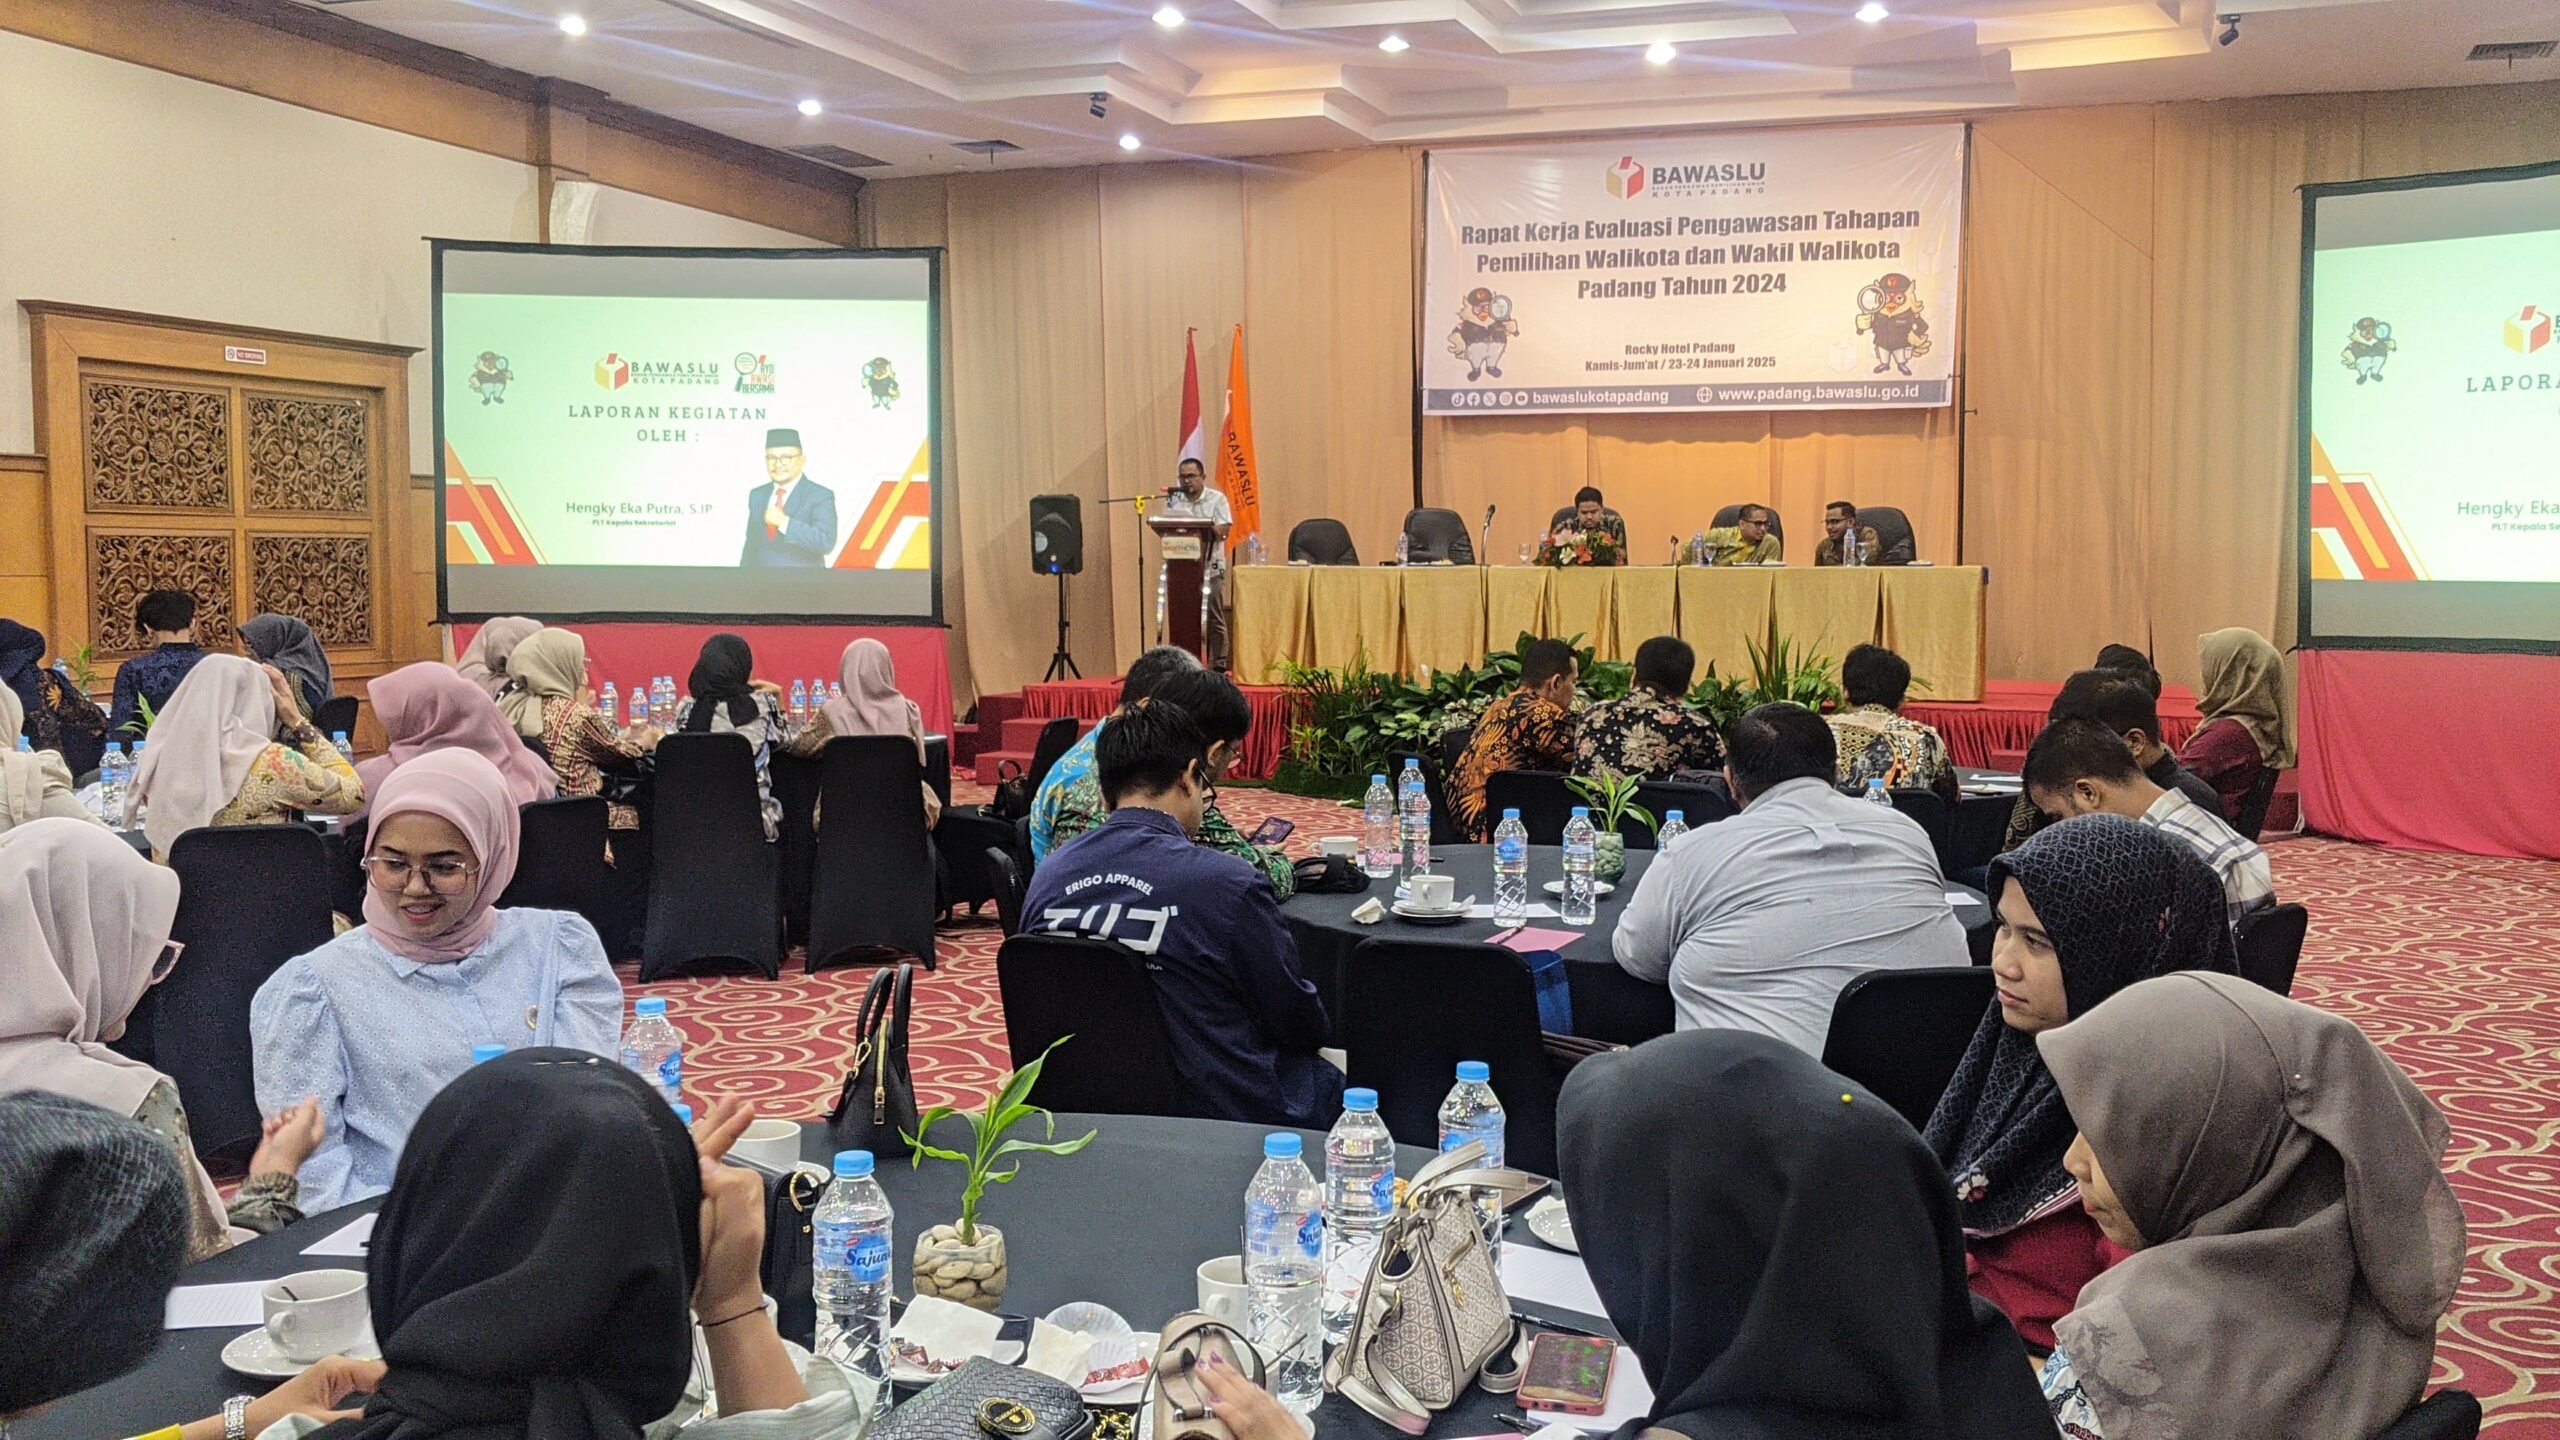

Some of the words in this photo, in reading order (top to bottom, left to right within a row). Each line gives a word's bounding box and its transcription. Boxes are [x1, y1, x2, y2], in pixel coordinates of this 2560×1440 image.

[1652, 162, 1766, 185] BAWASLU
[1652, 190, 1692, 198] KOTA
[1700, 187, 1765, 196] PADANG
[1461, 224, 1520, 246] Rapat
[1524, 222, 1580, 243] Kerja
[1584, 217, 1673, 240] Evaluasi
[1677, 214, 1818, 237] Pengawasan
[1823, 209, 1920, 231] Tahapan
[1476, 251, 1581, 274] Pemilihan
[1585, 248, 1680, 270] Walikota
[1685, 245, 1726, 266] dan
[1731, 242, 1794, 264] Wakil
[1799, 240, 1901, 262] Walikota
[1578, 278, 1657, 300] Padang
[1661, 275, 1727, 296] Tahun
[1732, 273, 1787, 294] 2024
[1625, 344, 1659, 356] Rocky
[1660, 343, 1690, 354] Hotel
[1693, 342, 1736, 354] Padang
[631, 361, 718, 374] BAWASLU
[760, 364, 774, 374] AYO
[1585, 358, 1659, 371] Kamis-Jum'at
[1668, 358, 1700, 370] 23-24
[1702, 356, 1745, 369] Januari
[1747, 356, 1776, 368] 2025
[742, 383, 775, 394] BERSAMA
[1718, 384, 1919, 403] www.padang.bawaslu.go.id
[1533, 389, 1669, 406] bawaslukotapadang
[568, 405, 660, 419] LAPORAN
[669, 406, 767, 420] KEGIATAN
[637, 429, 686, 442] OLEH
[566, 502, 616, 516] Hengky
[620, 502, 642, 514] Eka
[647, 503, 684, 515] Putra,
[2457, 500, 2524, 519] Hengky
[2530, 499, 2560, 514] Eka
[606, 519, 633, 527] Kepala
[2491, 523, 2508, 531] PLT
[2510, 522, 2547, 532] Kepala
[1065, 874, 1103, 896] ERIGO
[1104, 873, 1154, 896] APPAREL
